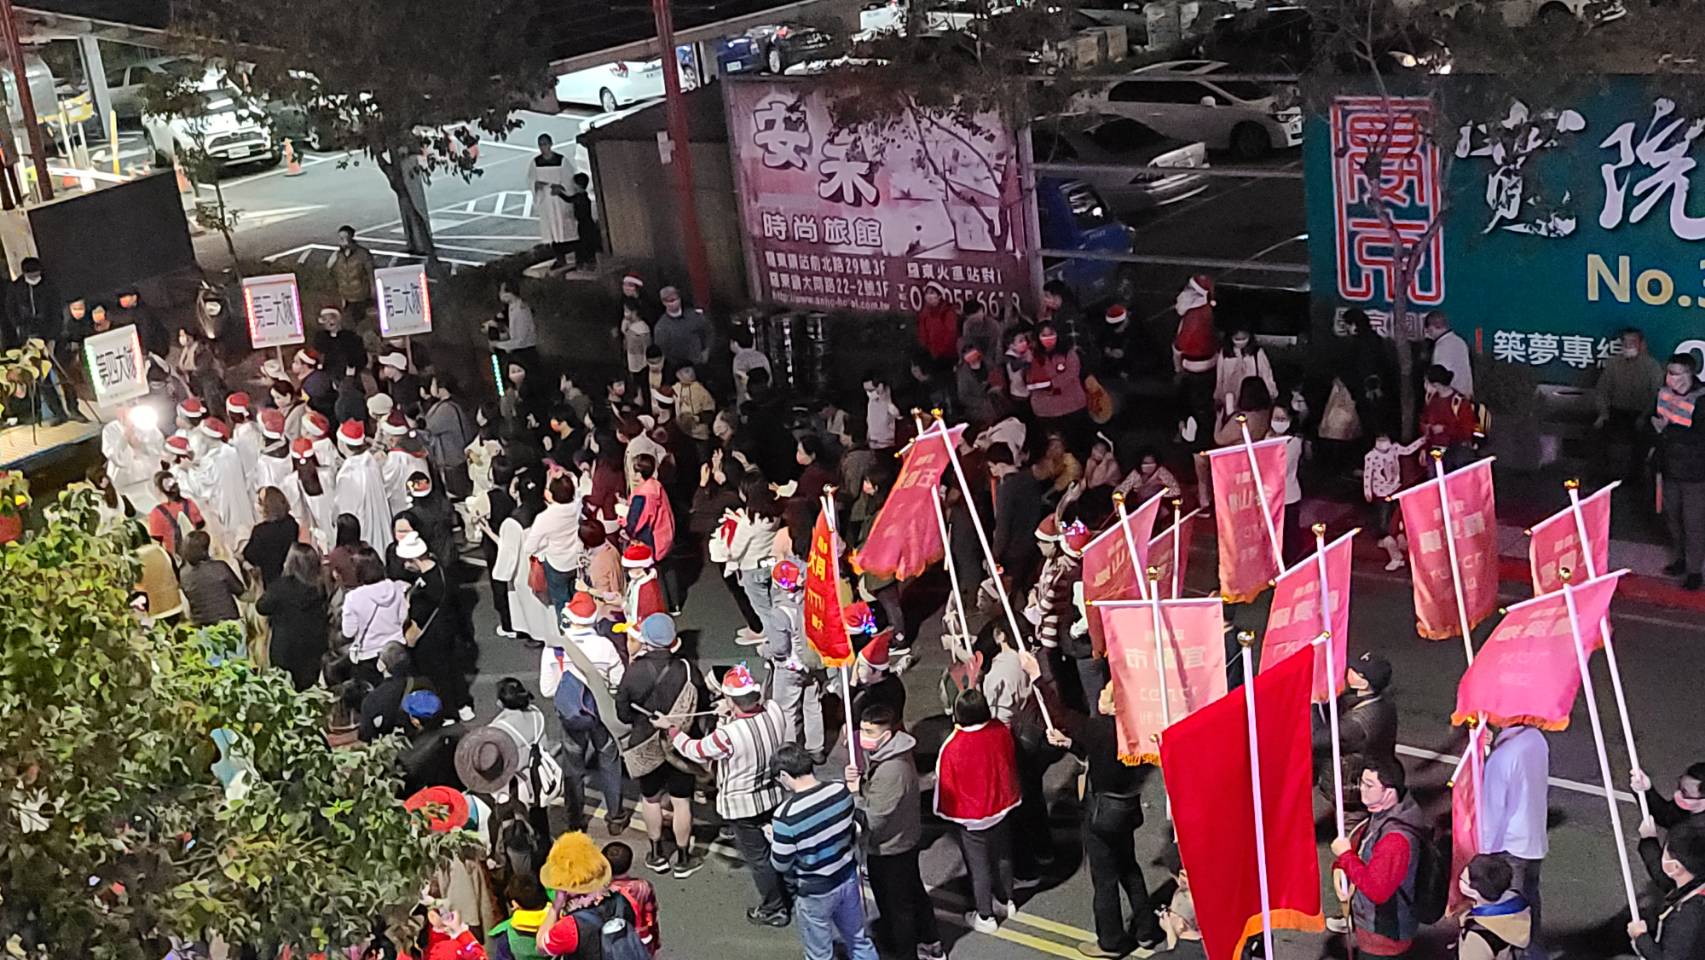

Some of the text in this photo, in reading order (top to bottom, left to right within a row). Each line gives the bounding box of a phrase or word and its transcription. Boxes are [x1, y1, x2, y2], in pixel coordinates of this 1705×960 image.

[763, 212, 882, 247] 時尚旅館
[907, 262, 1003, 285] 羅東火車站對
[1586, 253, 1705, 309] No.
